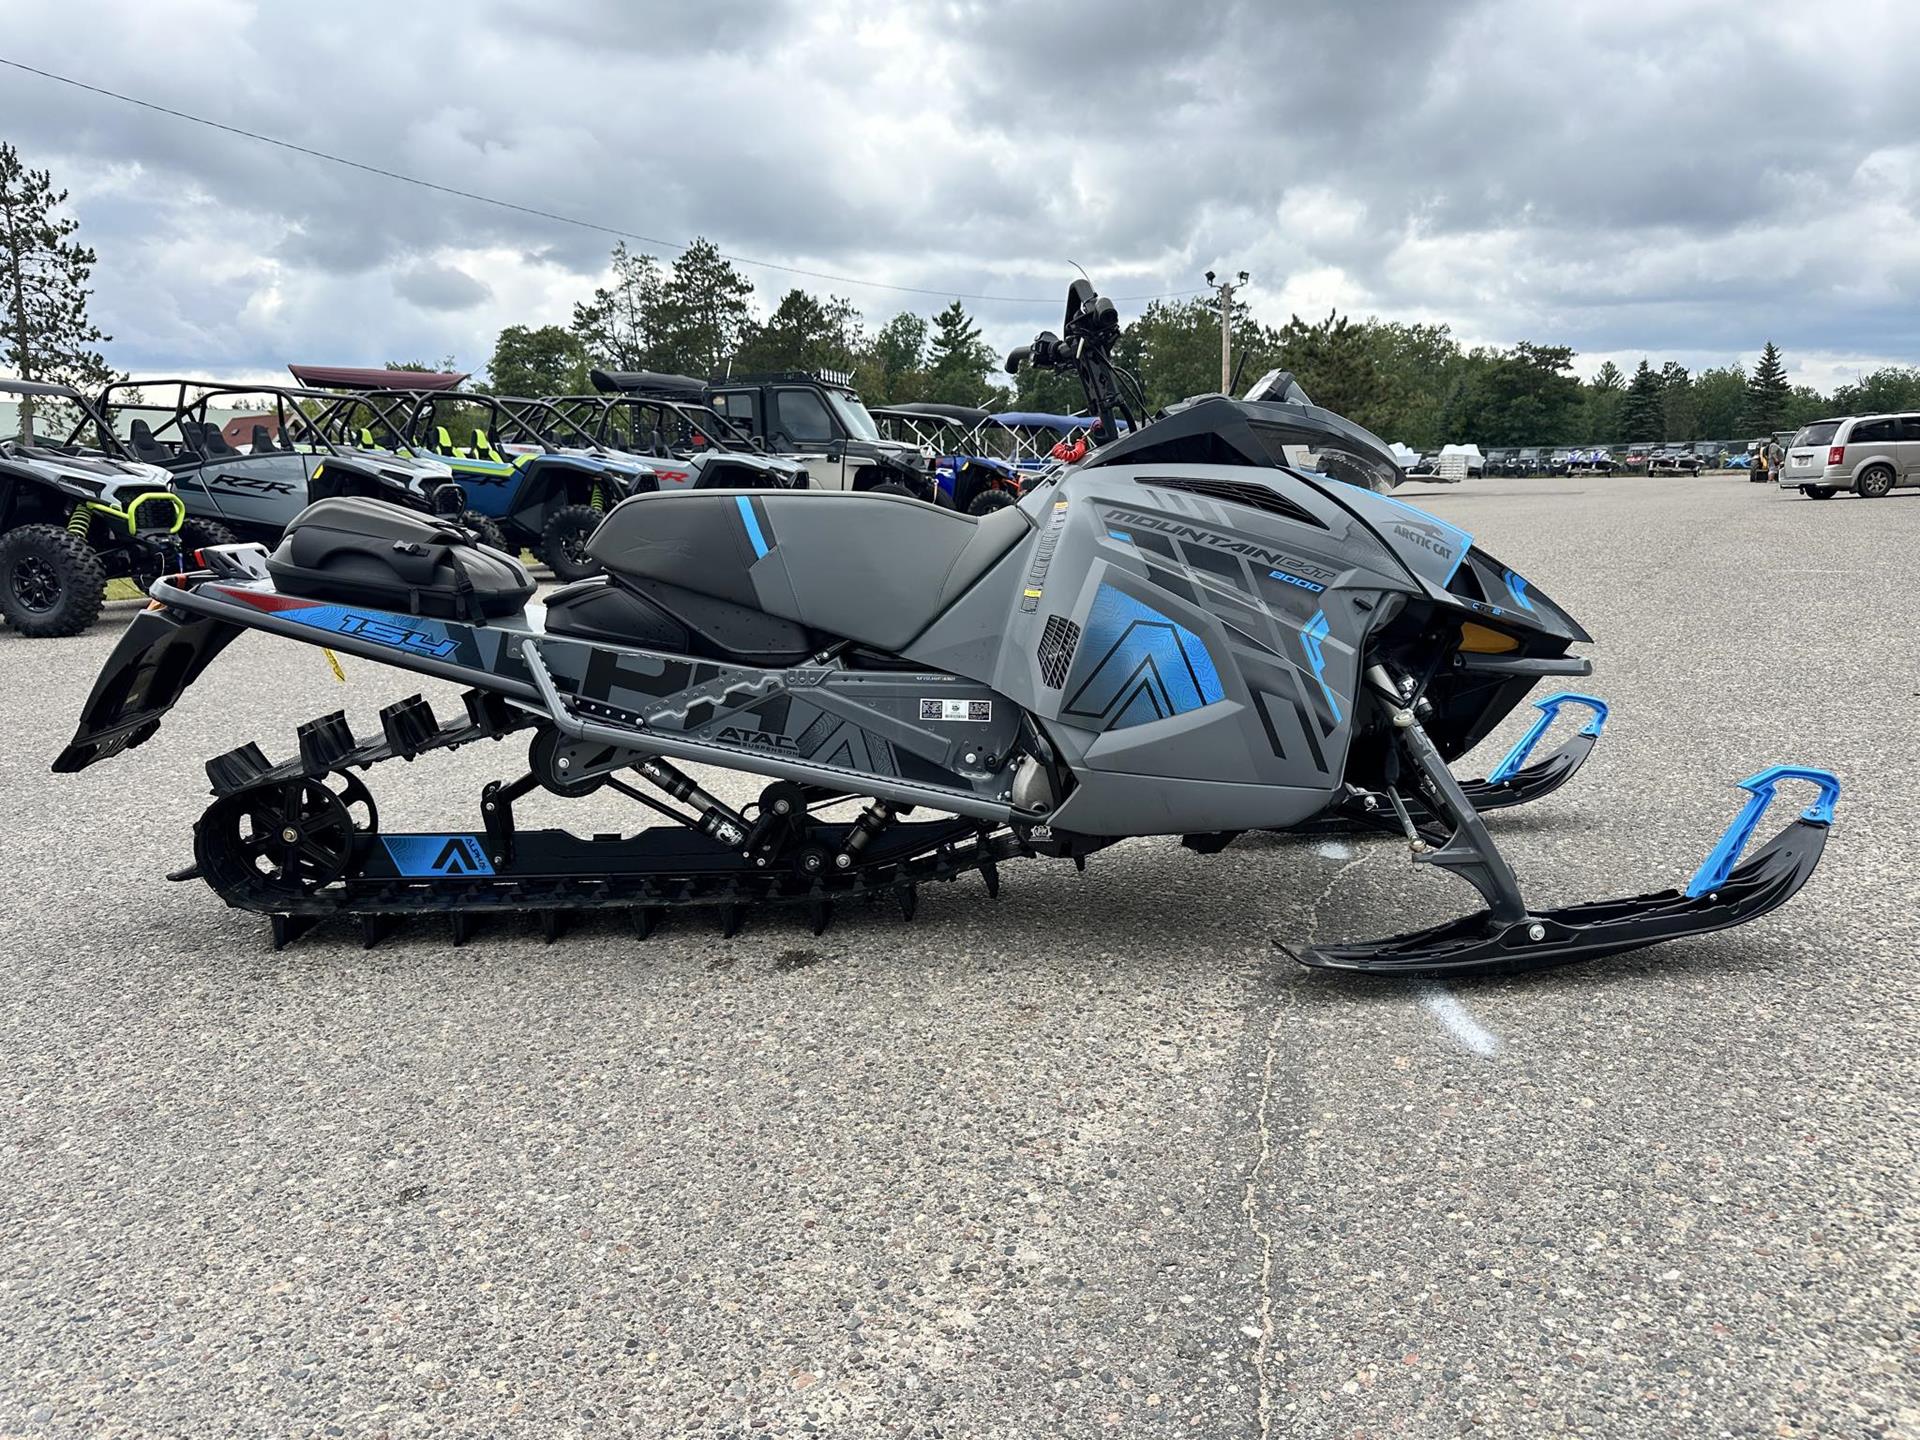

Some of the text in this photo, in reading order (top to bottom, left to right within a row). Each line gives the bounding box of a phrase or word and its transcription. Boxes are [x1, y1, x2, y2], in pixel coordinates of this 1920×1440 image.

[210, 474, 297, 496] RZR
[1393, 524, 1452, 560] ARCTIC CAT
[1268, 570, 1325, 593] 8000
[340, 614, 460, 658] 154
[717, 726, 799, 750] ATAC
[742, 742, 799, 757] SUSPENSION
